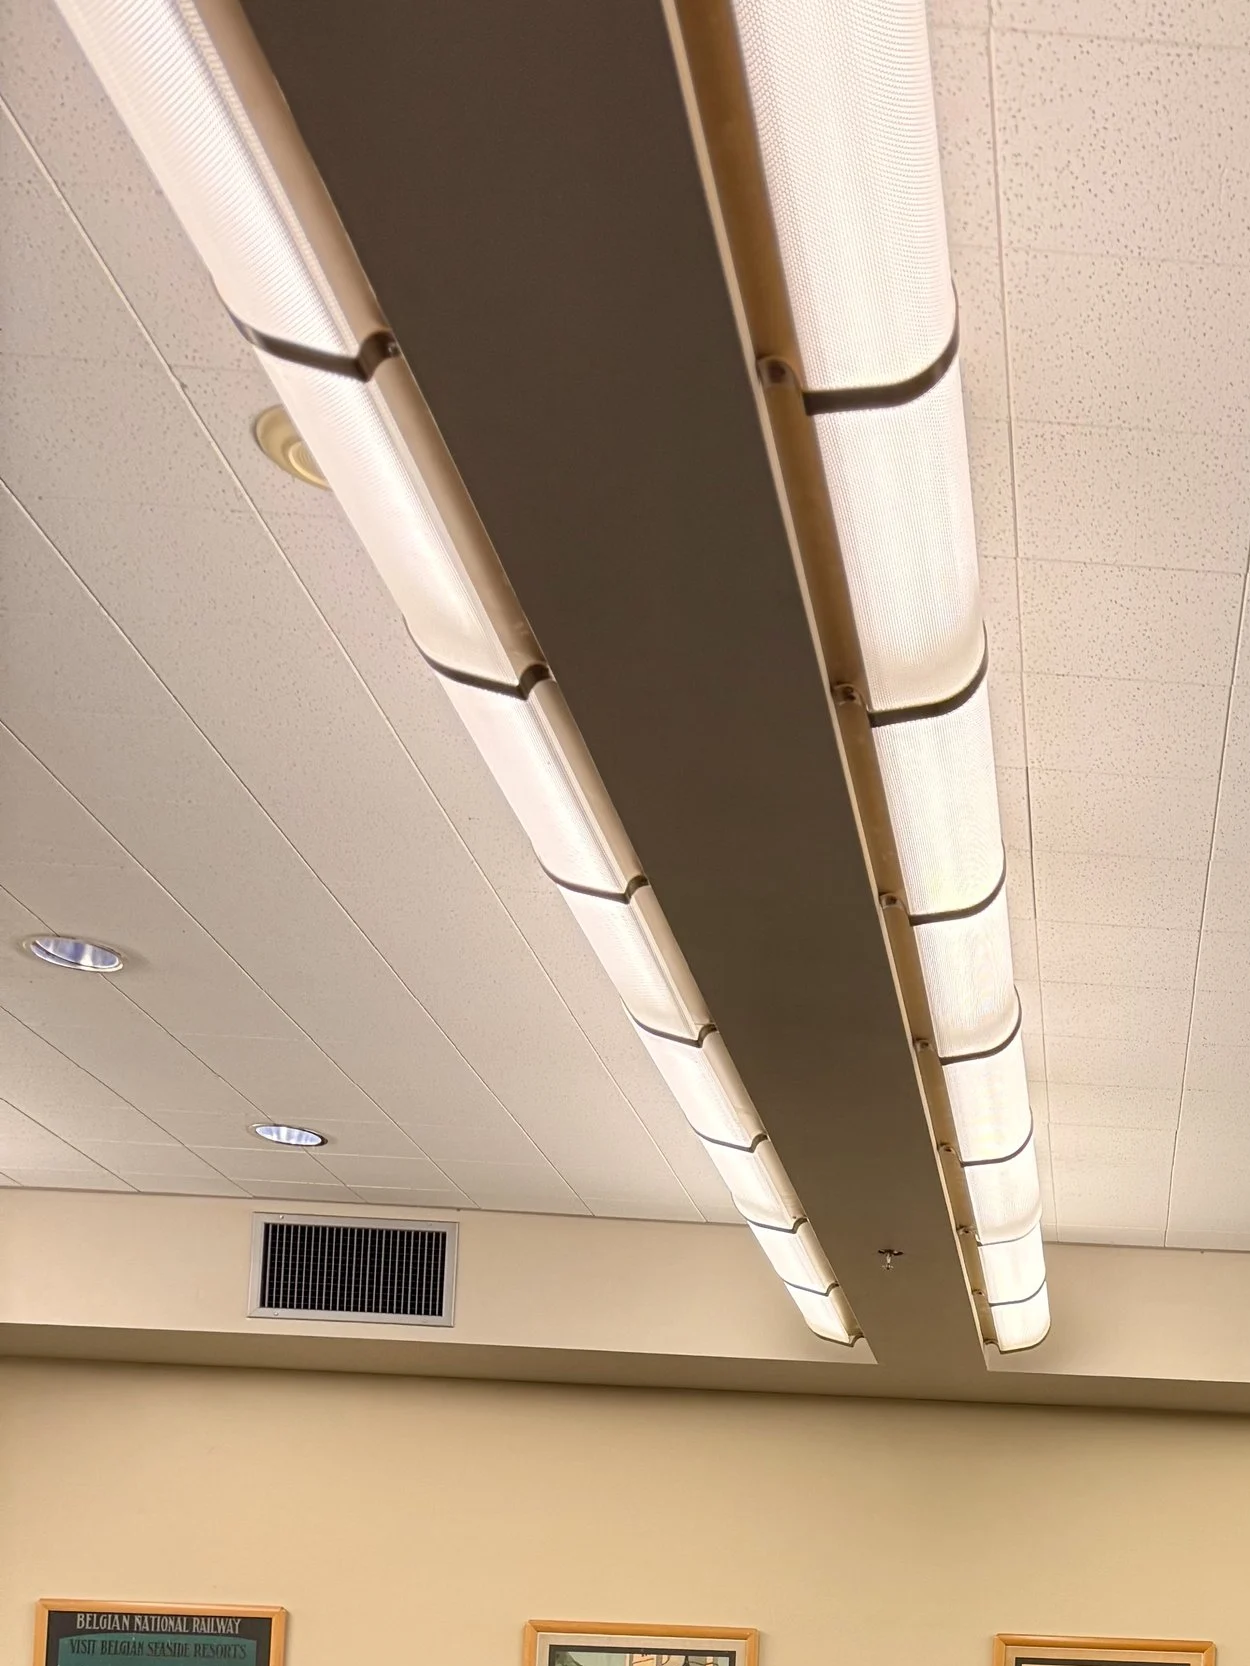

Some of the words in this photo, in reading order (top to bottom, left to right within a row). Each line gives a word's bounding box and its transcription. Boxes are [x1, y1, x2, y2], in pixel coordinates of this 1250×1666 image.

[76, 1613, 130, 1631] BELGIAN
[134, 1615, 189, 1633] NATIONAL
[192, 1617, 242, 1634] RAILWAY
[69, 1639, 95, 1654] VISIT
[100, 1640, 144, 1656] BELGIAN
[147, 1641, 190, 1658] SEASIDE
[193, 1643, 247, 1660] RESORTS
